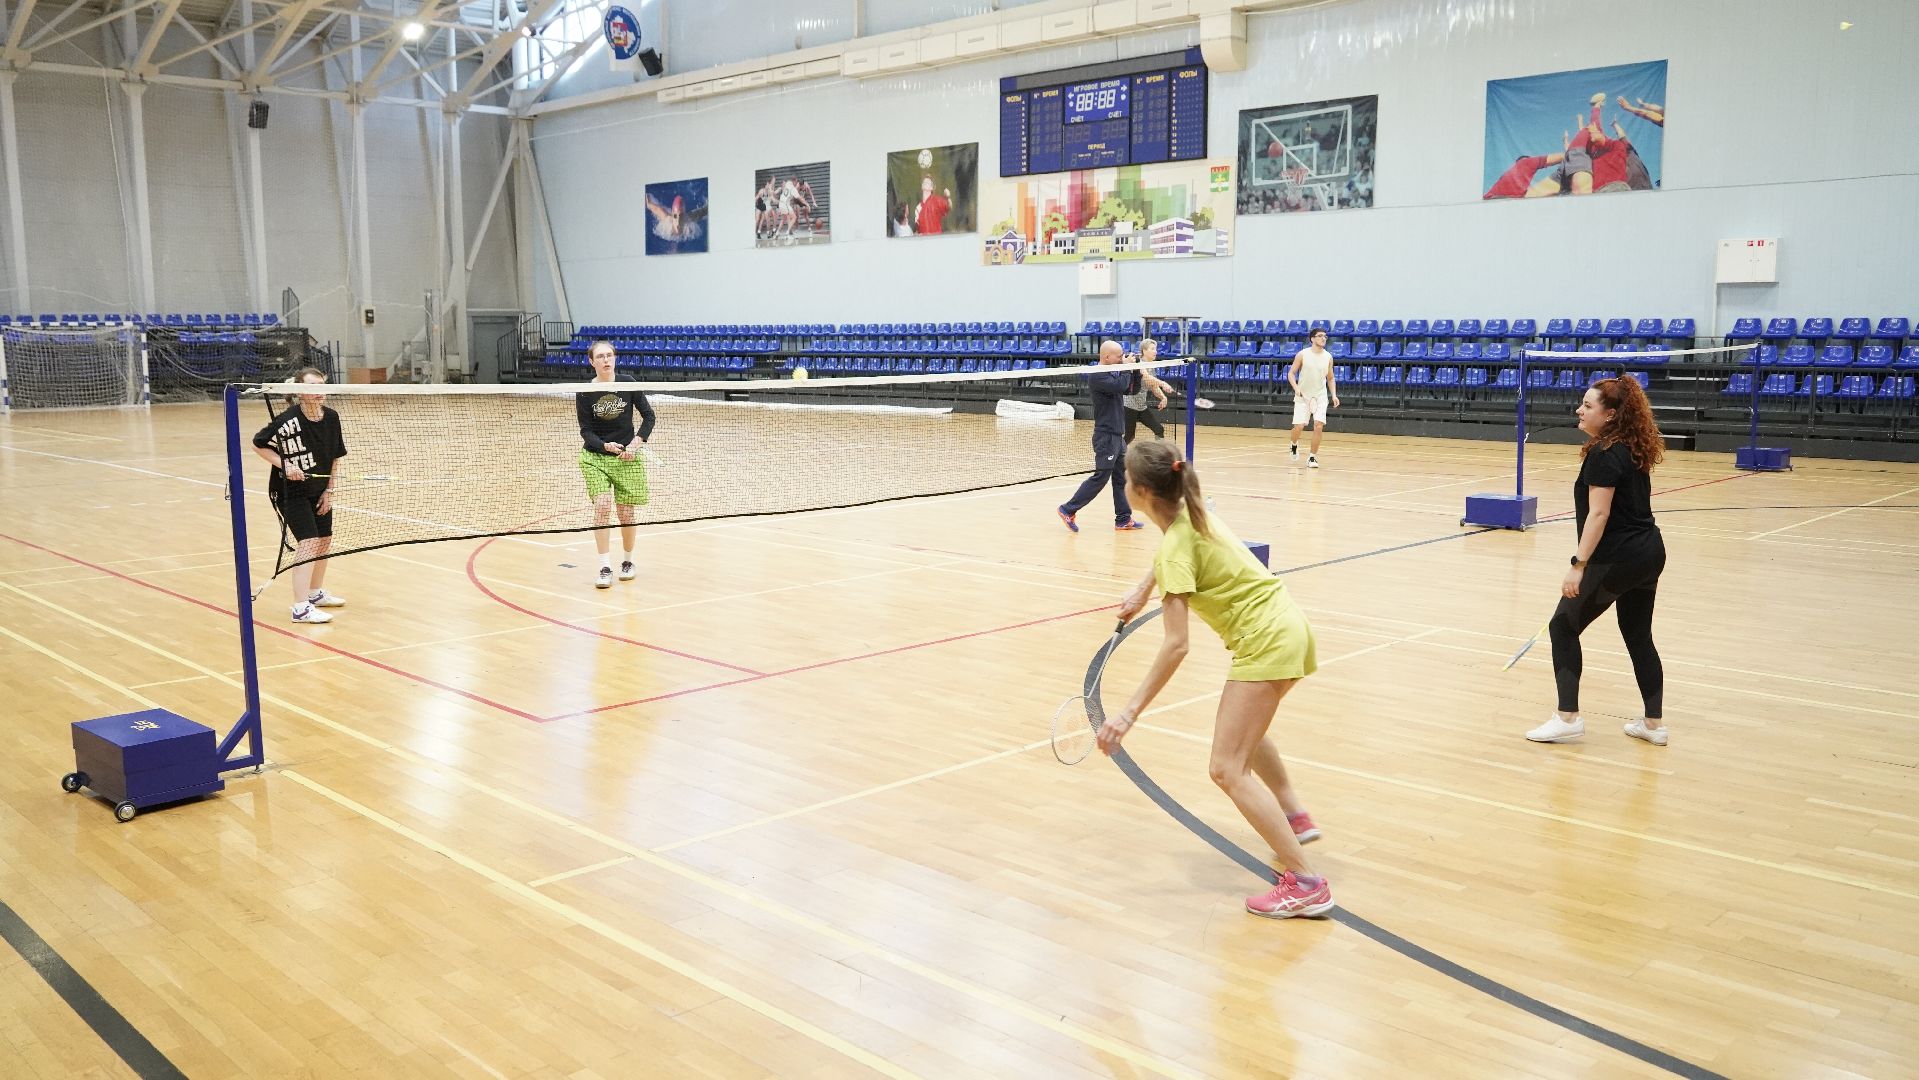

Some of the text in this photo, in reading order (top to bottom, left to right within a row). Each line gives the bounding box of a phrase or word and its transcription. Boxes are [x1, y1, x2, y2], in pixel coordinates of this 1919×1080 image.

[1145, 74, 1165, 84] ВРЕМЯ
[1179, 69, 1198, 79] ФОЛЫ
[1073, 79, 1121, 92] ИГРОВОЕ ВРЕМЯ
[279, 435, 307, 455] IAL
